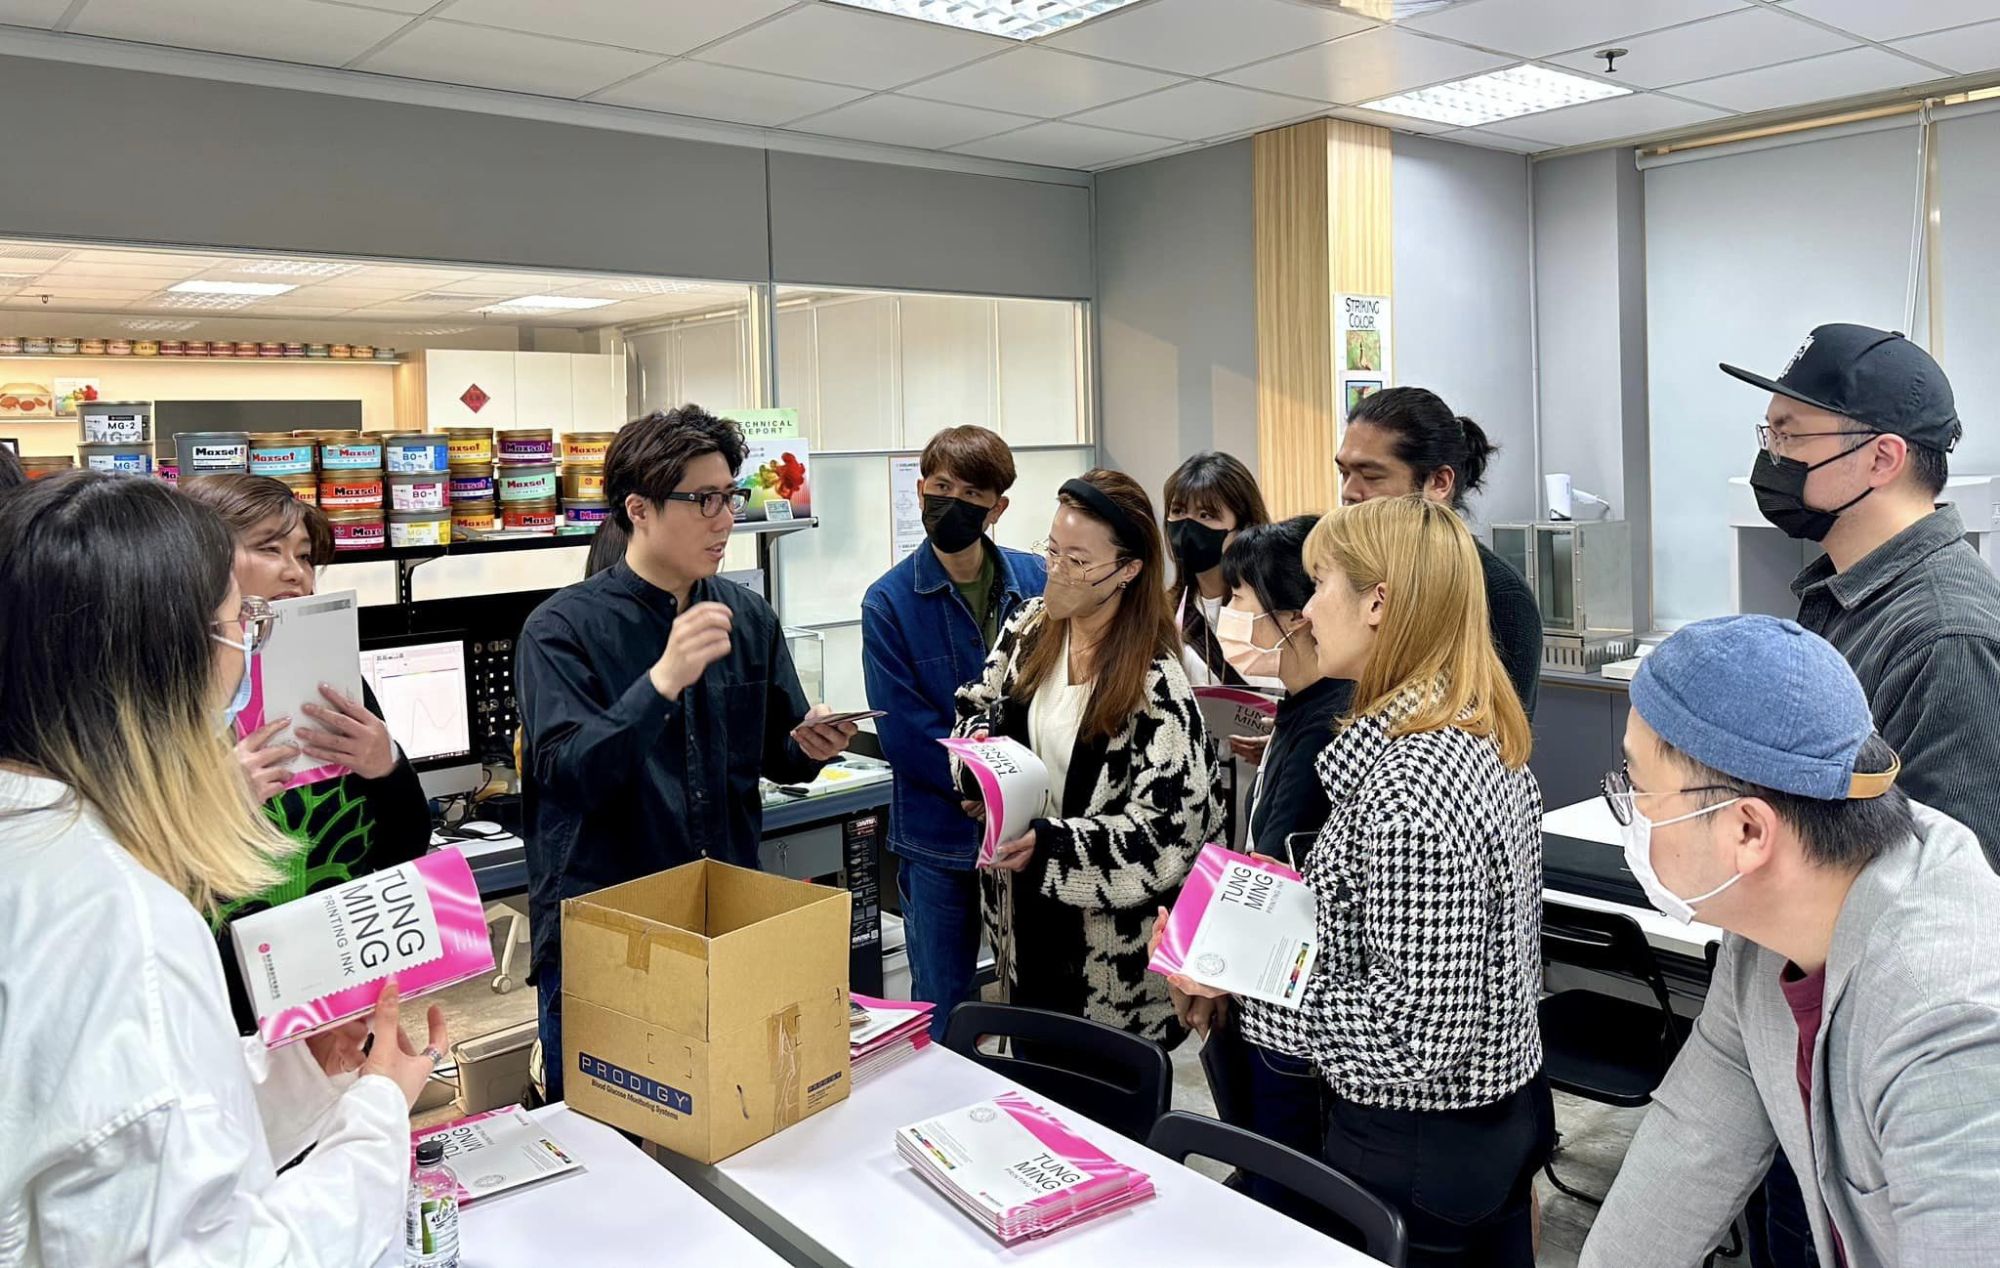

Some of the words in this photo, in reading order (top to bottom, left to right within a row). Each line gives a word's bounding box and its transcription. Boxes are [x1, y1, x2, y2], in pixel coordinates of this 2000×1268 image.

[1345, 297, 1380, 314] STRIKING
[1348, 313, 1376, 328] COLOR
[195, 447, 238, 456] Maxsel
[252, 452, 295, 461] Maxsel
[339, 448, 376, 457] Maxsel
[402, 453, 428, 461] BO-1
[334, 485, 377, 496] Maxsel
[507, 478, 545, 488] Maxsel
[412, 490, 438, 498] BO-1
[1236, 704, 1266, 720] TUN
[1220, 866, 1252, 903] TUNG
[1243, 874, 1273, 910] MING
[375, 869, 425, 957] TUNG
[339, 883, 390, 969] MING
[324, 894, 349, 950] PRINTING
[340, 952, 356, 976] INK
[606, 1085, 627, 1099] Glucose
[627, 1093, 655, 1112] Monitoring
[655, 1104, 679, 1120] Systems
[452, 1127, 486, 1152] MING
[1013, 1161, 1062, 1190] MING
[1032, 1152, 1081, 1183] TUNG
